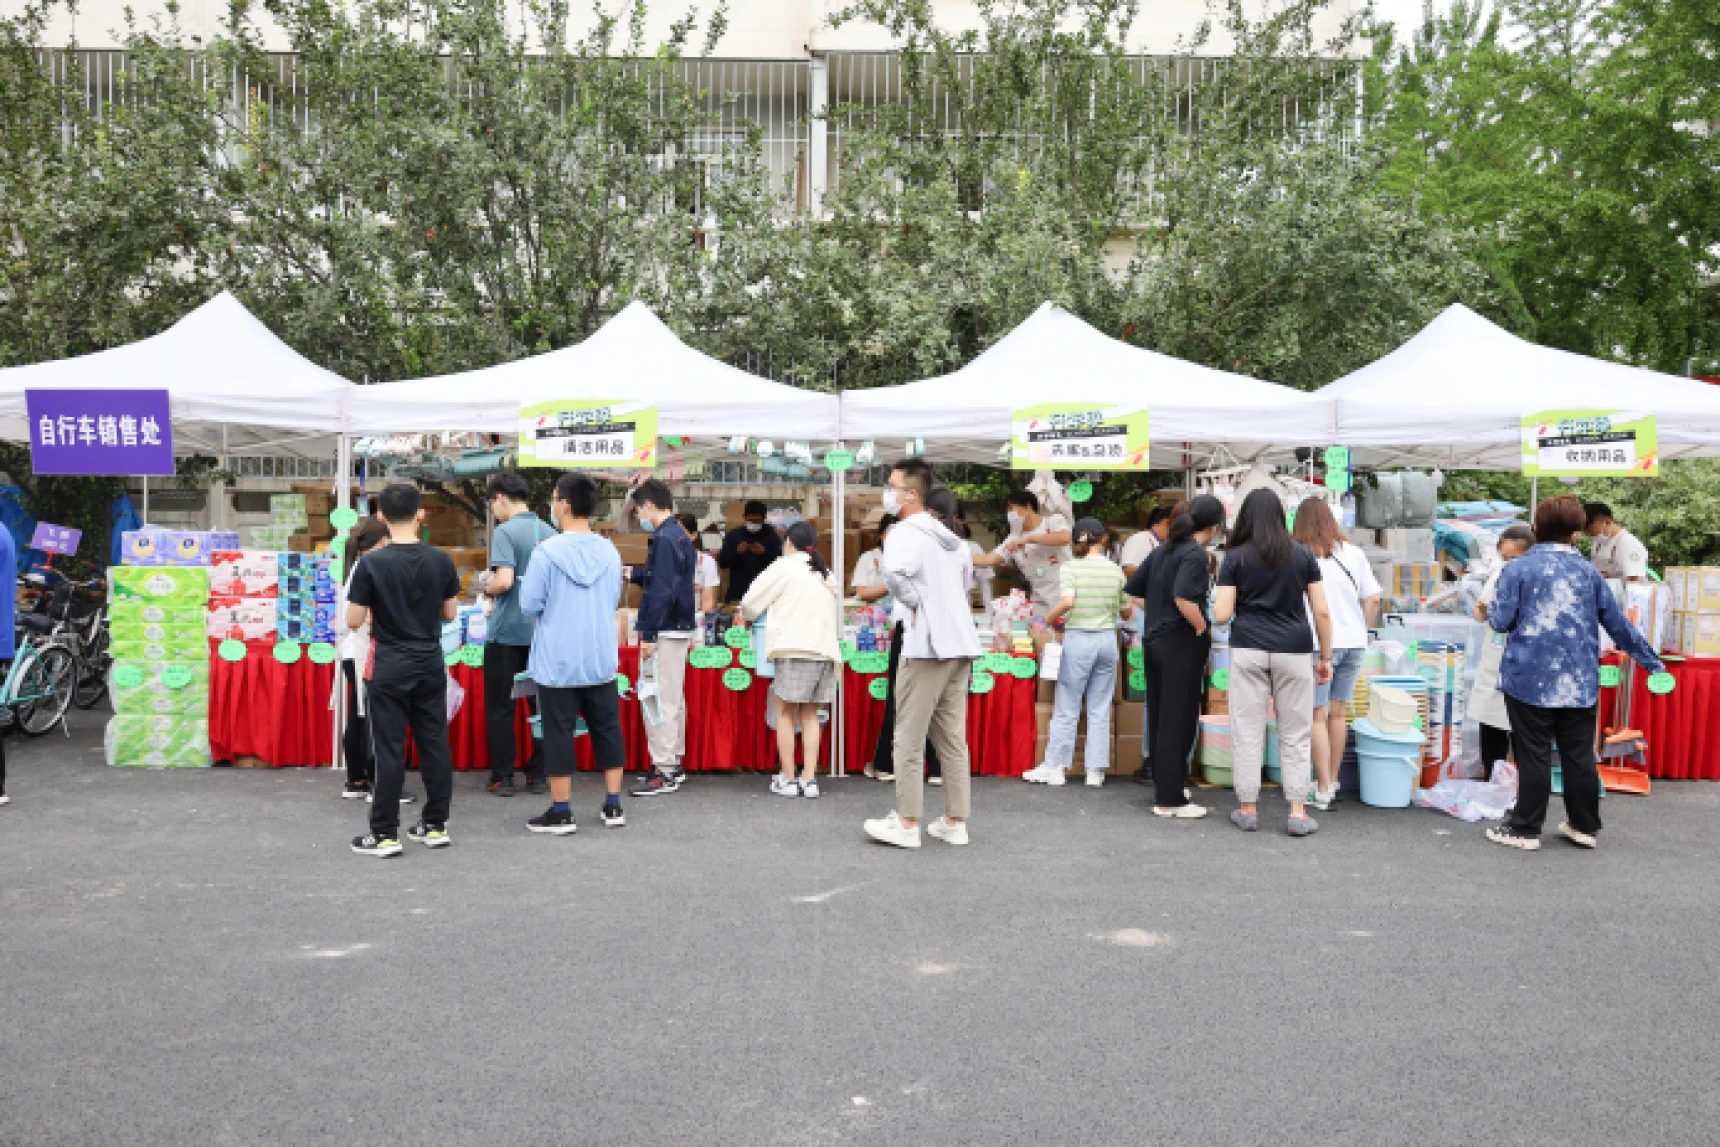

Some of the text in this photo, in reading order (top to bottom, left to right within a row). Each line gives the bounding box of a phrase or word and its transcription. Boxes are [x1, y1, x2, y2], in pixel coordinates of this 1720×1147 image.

[39, 414, 162, 446] 自行车销售处
[562, 439, 624, 455] 清洁用品
[1565, 448, 1627, 464] 收纳用品
